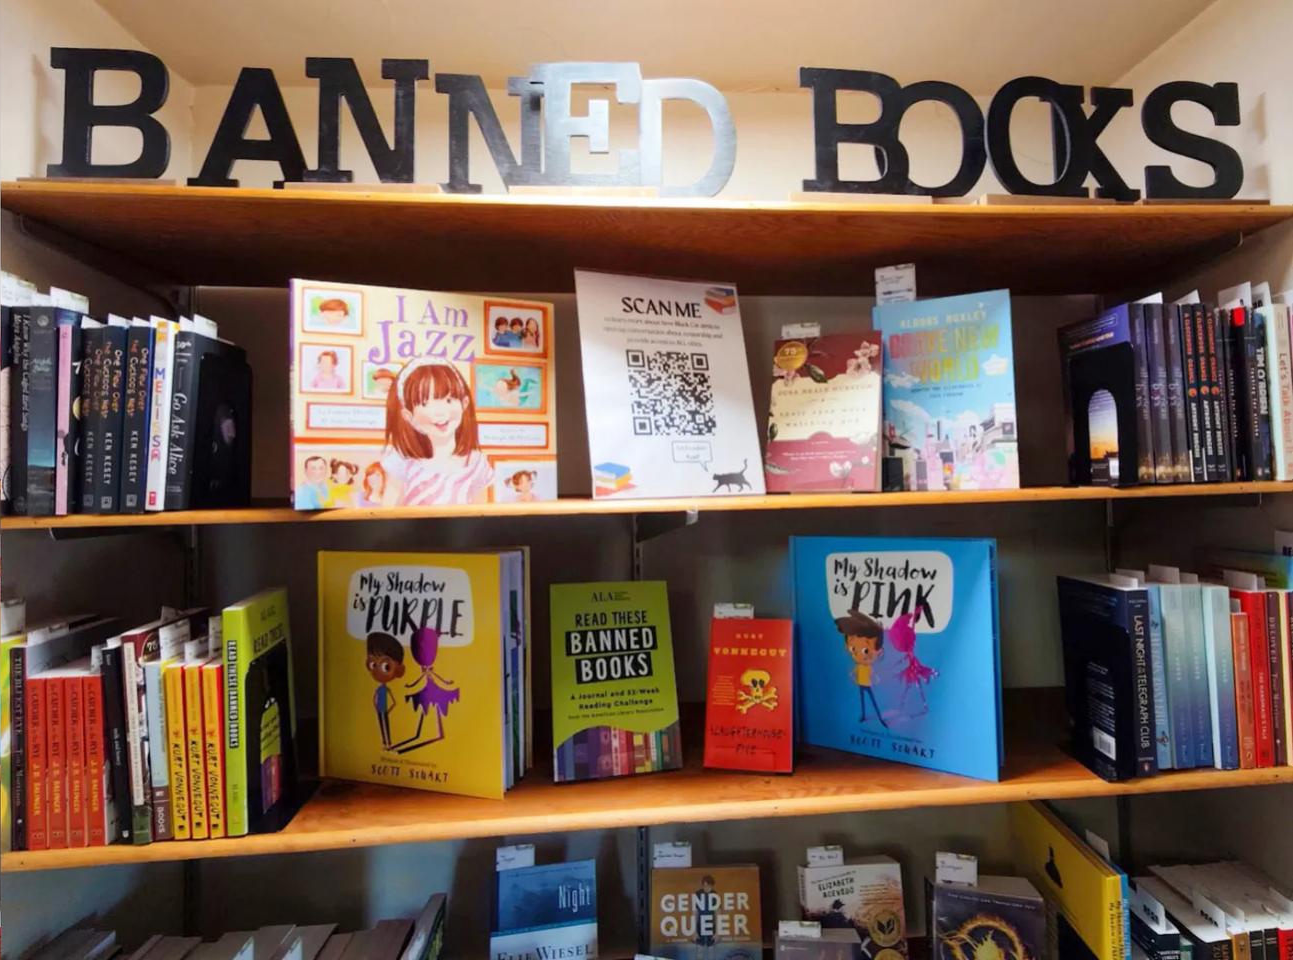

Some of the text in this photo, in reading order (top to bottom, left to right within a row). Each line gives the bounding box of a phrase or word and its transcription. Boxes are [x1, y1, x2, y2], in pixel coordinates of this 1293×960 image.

[47, 47, 737, 198] BANNED
[799, 67, 1244, 203] BOOKS
[396, 295, 468, 327] I Am
[622, 296, 702, 319] SCAN ME
[368, 320, 476, 365] Jazz
[1256, 347, 1265, 369] TIM
[168, 392, 187, 475] Go Ask Alice
[104, 432, 113, 485] KEN KESEY
[129, 430, 138, 483] KEN KESEY
[834, 557, 937, 581] My Shadow
[360, 571, 446, 595] My Shadow
[591, 591, 613, 602] ALA
[353, 593, 465, 637] is PURPLE
[834, 578, 935, 628] is PINK
[575, 610, 647, 627] READ THESE
[227, 640, 237, 661] READ
[570, 628, 654, 654] BANNED
[713, 647, 788, 657] VONNEGUT
[581, 653, 649, 682] BOOKS
[579, 689, 607, 700] Journal
[611, 689, 624, 697] and
[1134, 615, 1150, 749] LAST NIGHT TELEGRAPH CLUB
[229, 690, 239, 720] BANNED
[579, 698, 653, 711] Reading Challenge
[172, 741, 186, 822] KURT VONNEGUT
[190, 739, 203, 818] KURT VONNEGUT
[207, 741, 220, 820] KURT VONNEGUT
[818, 877, 855, 891] ELIZABETH
[823, 886, 855, 898] ACEVEDO
[558, 883, 591, 913] Night
[660, 892, 750, 913] GENDER
[660, 913, 750, 937] QUEER
[535, 943, 593, 960] WIESEL
